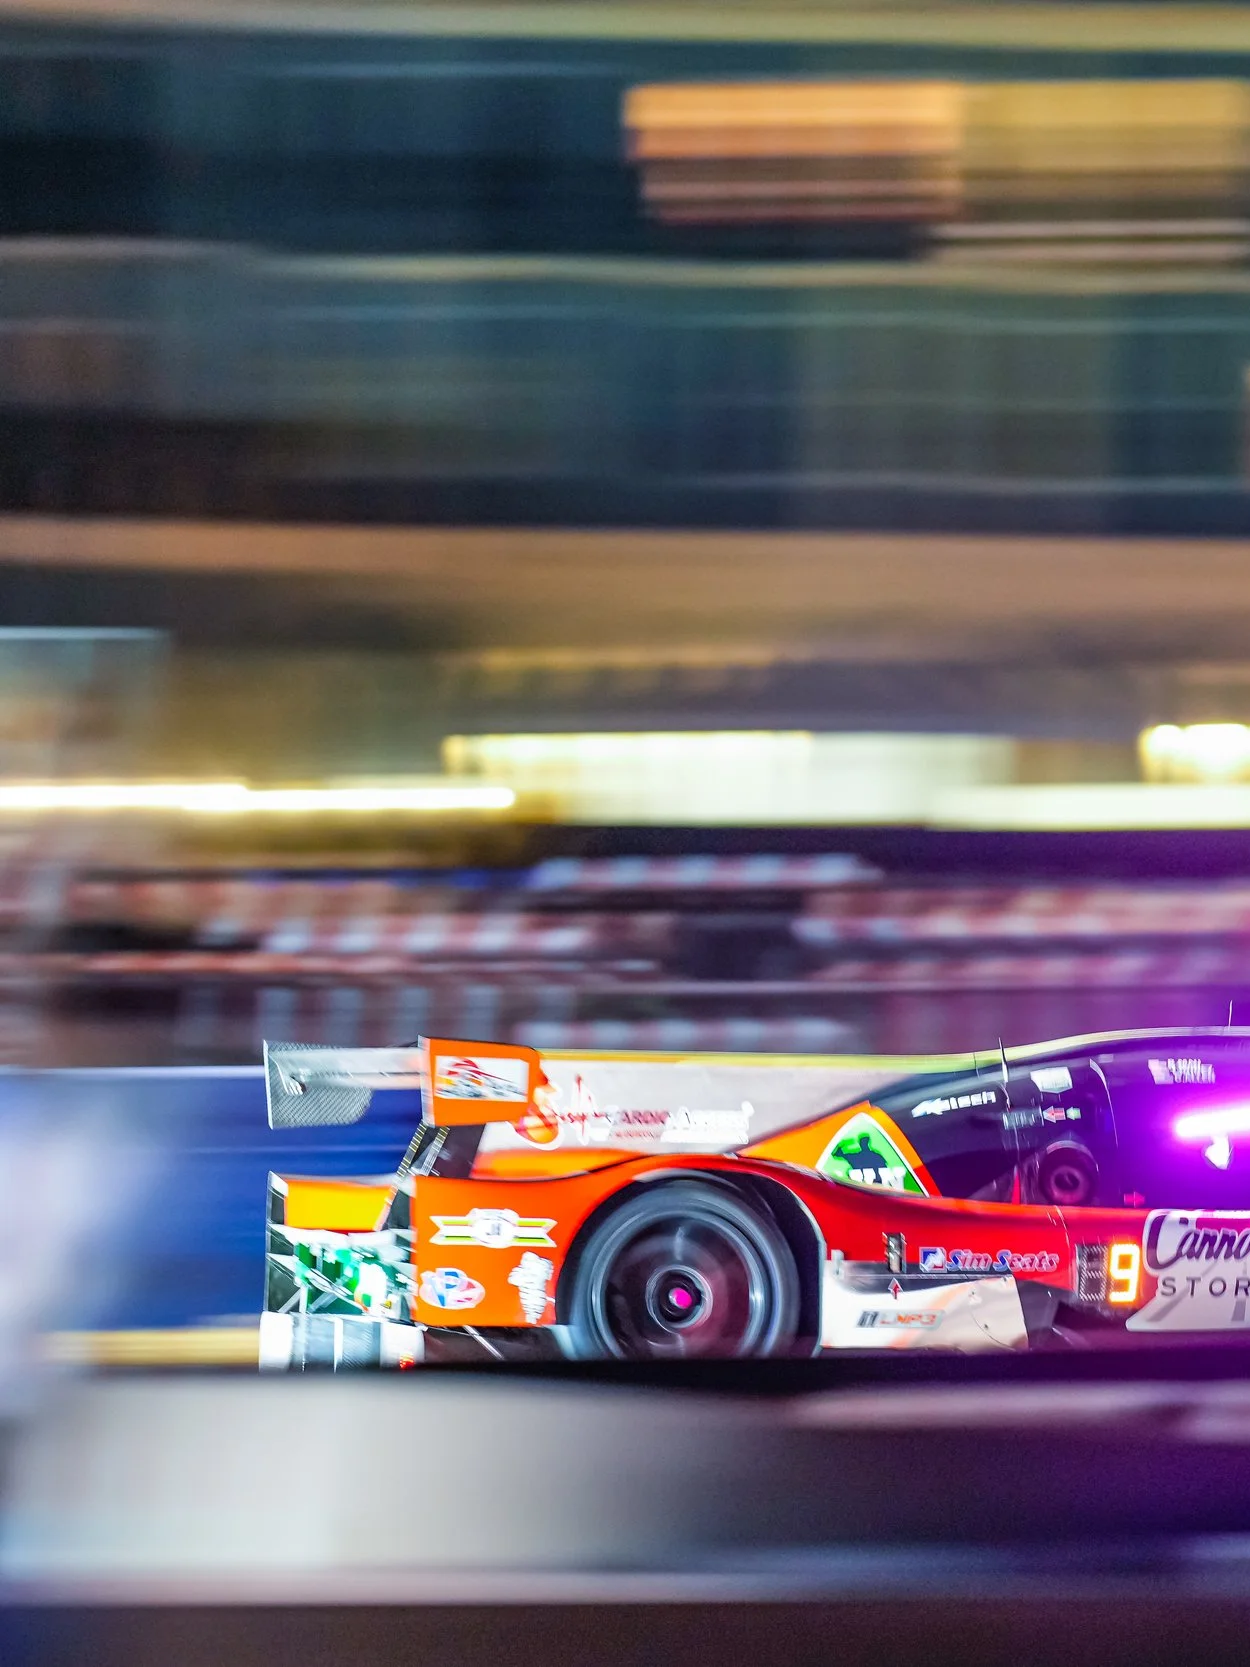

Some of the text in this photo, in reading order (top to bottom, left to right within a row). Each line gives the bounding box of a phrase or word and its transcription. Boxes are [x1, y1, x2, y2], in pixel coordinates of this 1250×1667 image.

[947, 1249, 1059, 1272] Sim Seats
[1109, 1244, 1141, 1303] 9
